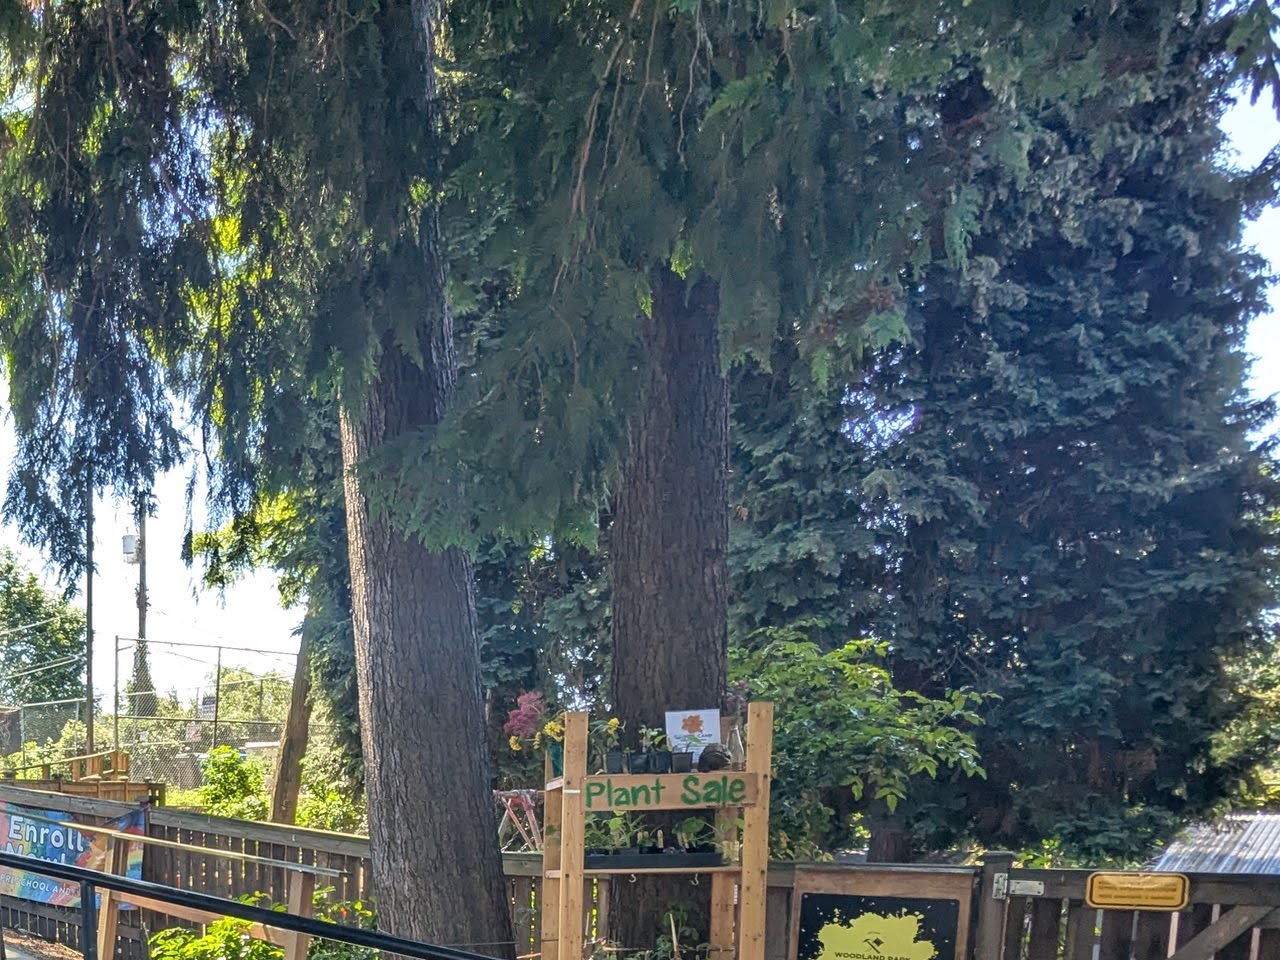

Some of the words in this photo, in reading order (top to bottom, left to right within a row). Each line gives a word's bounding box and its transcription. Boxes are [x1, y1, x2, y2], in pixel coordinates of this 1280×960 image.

[585, 777, 666, 808] Plant
[681, 775, 747, 806] Sale
[8, 814, 84, 852] Enroll
